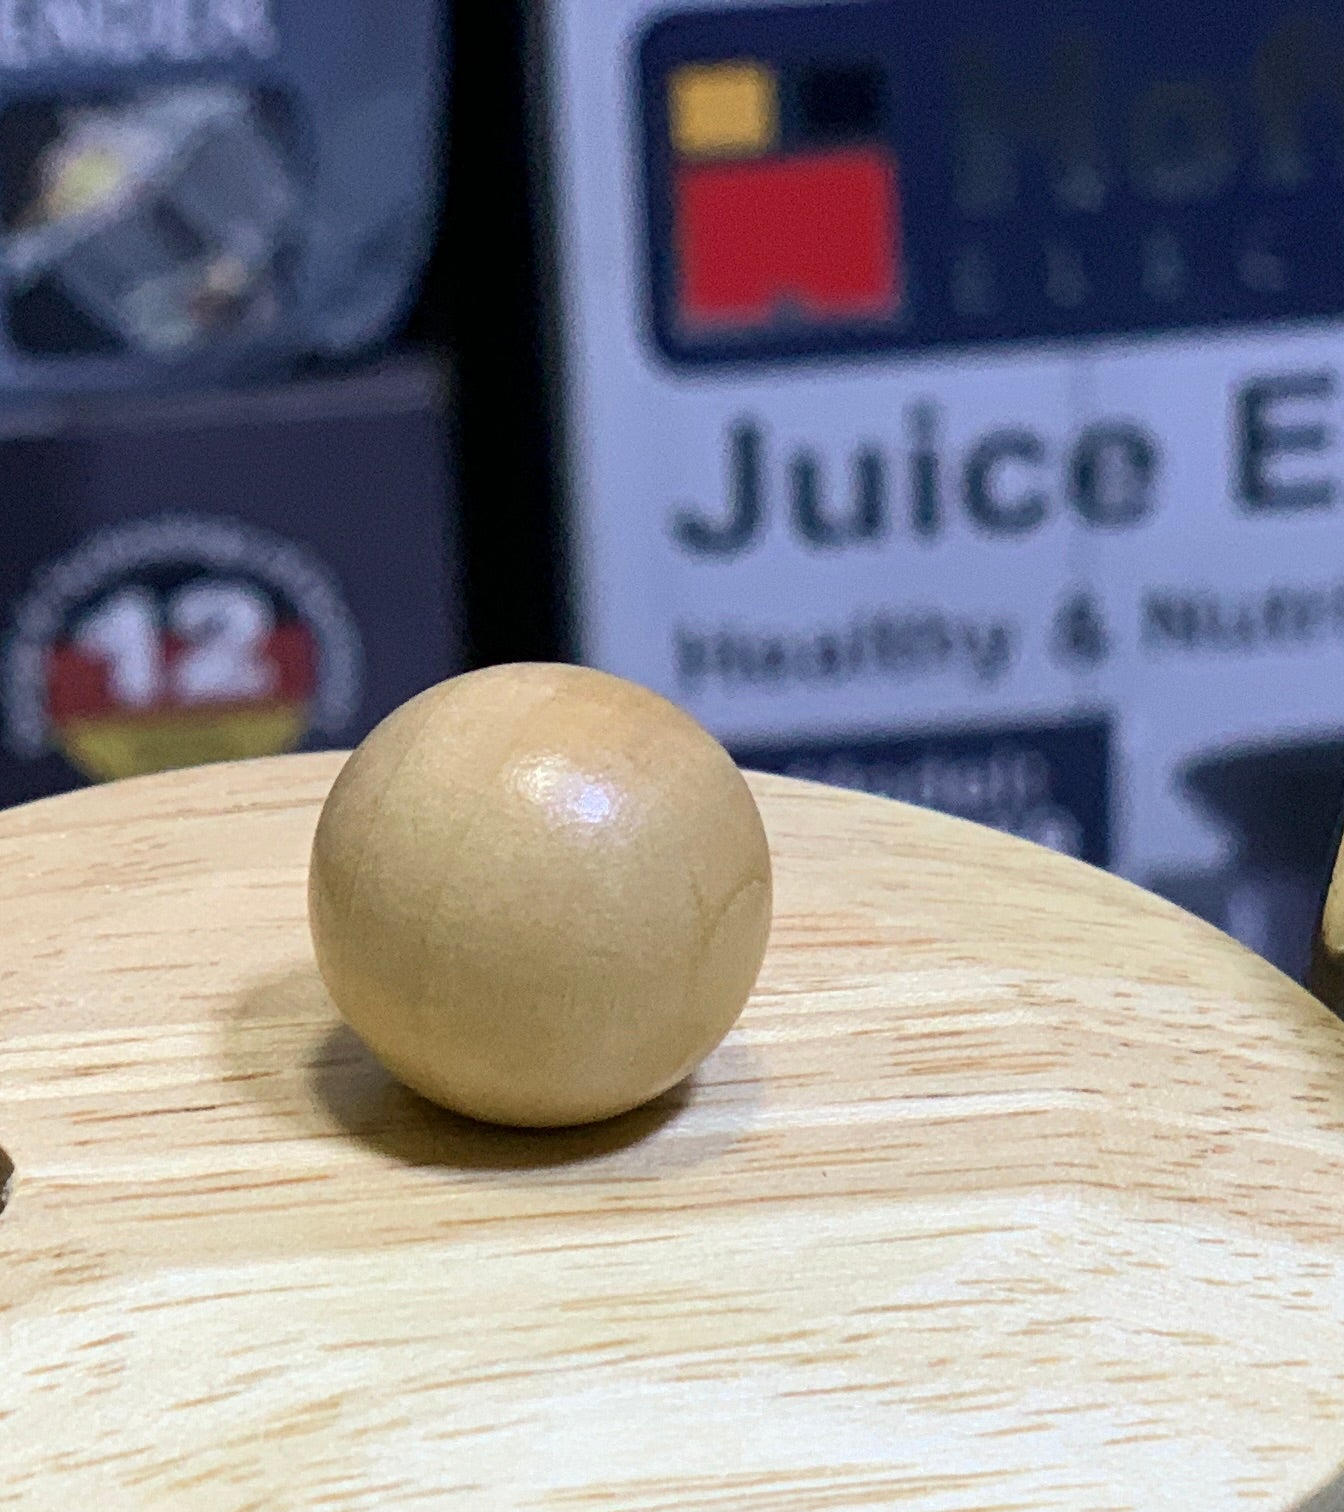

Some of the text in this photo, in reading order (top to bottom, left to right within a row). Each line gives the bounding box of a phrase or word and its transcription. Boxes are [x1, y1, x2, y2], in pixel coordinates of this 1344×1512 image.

[670, 398, 1162, 561] Juice
[72, 577, 280, 708] 12
[670, 610, 1014, 690] Healthy
[1052, 590, 1113, 670] &
